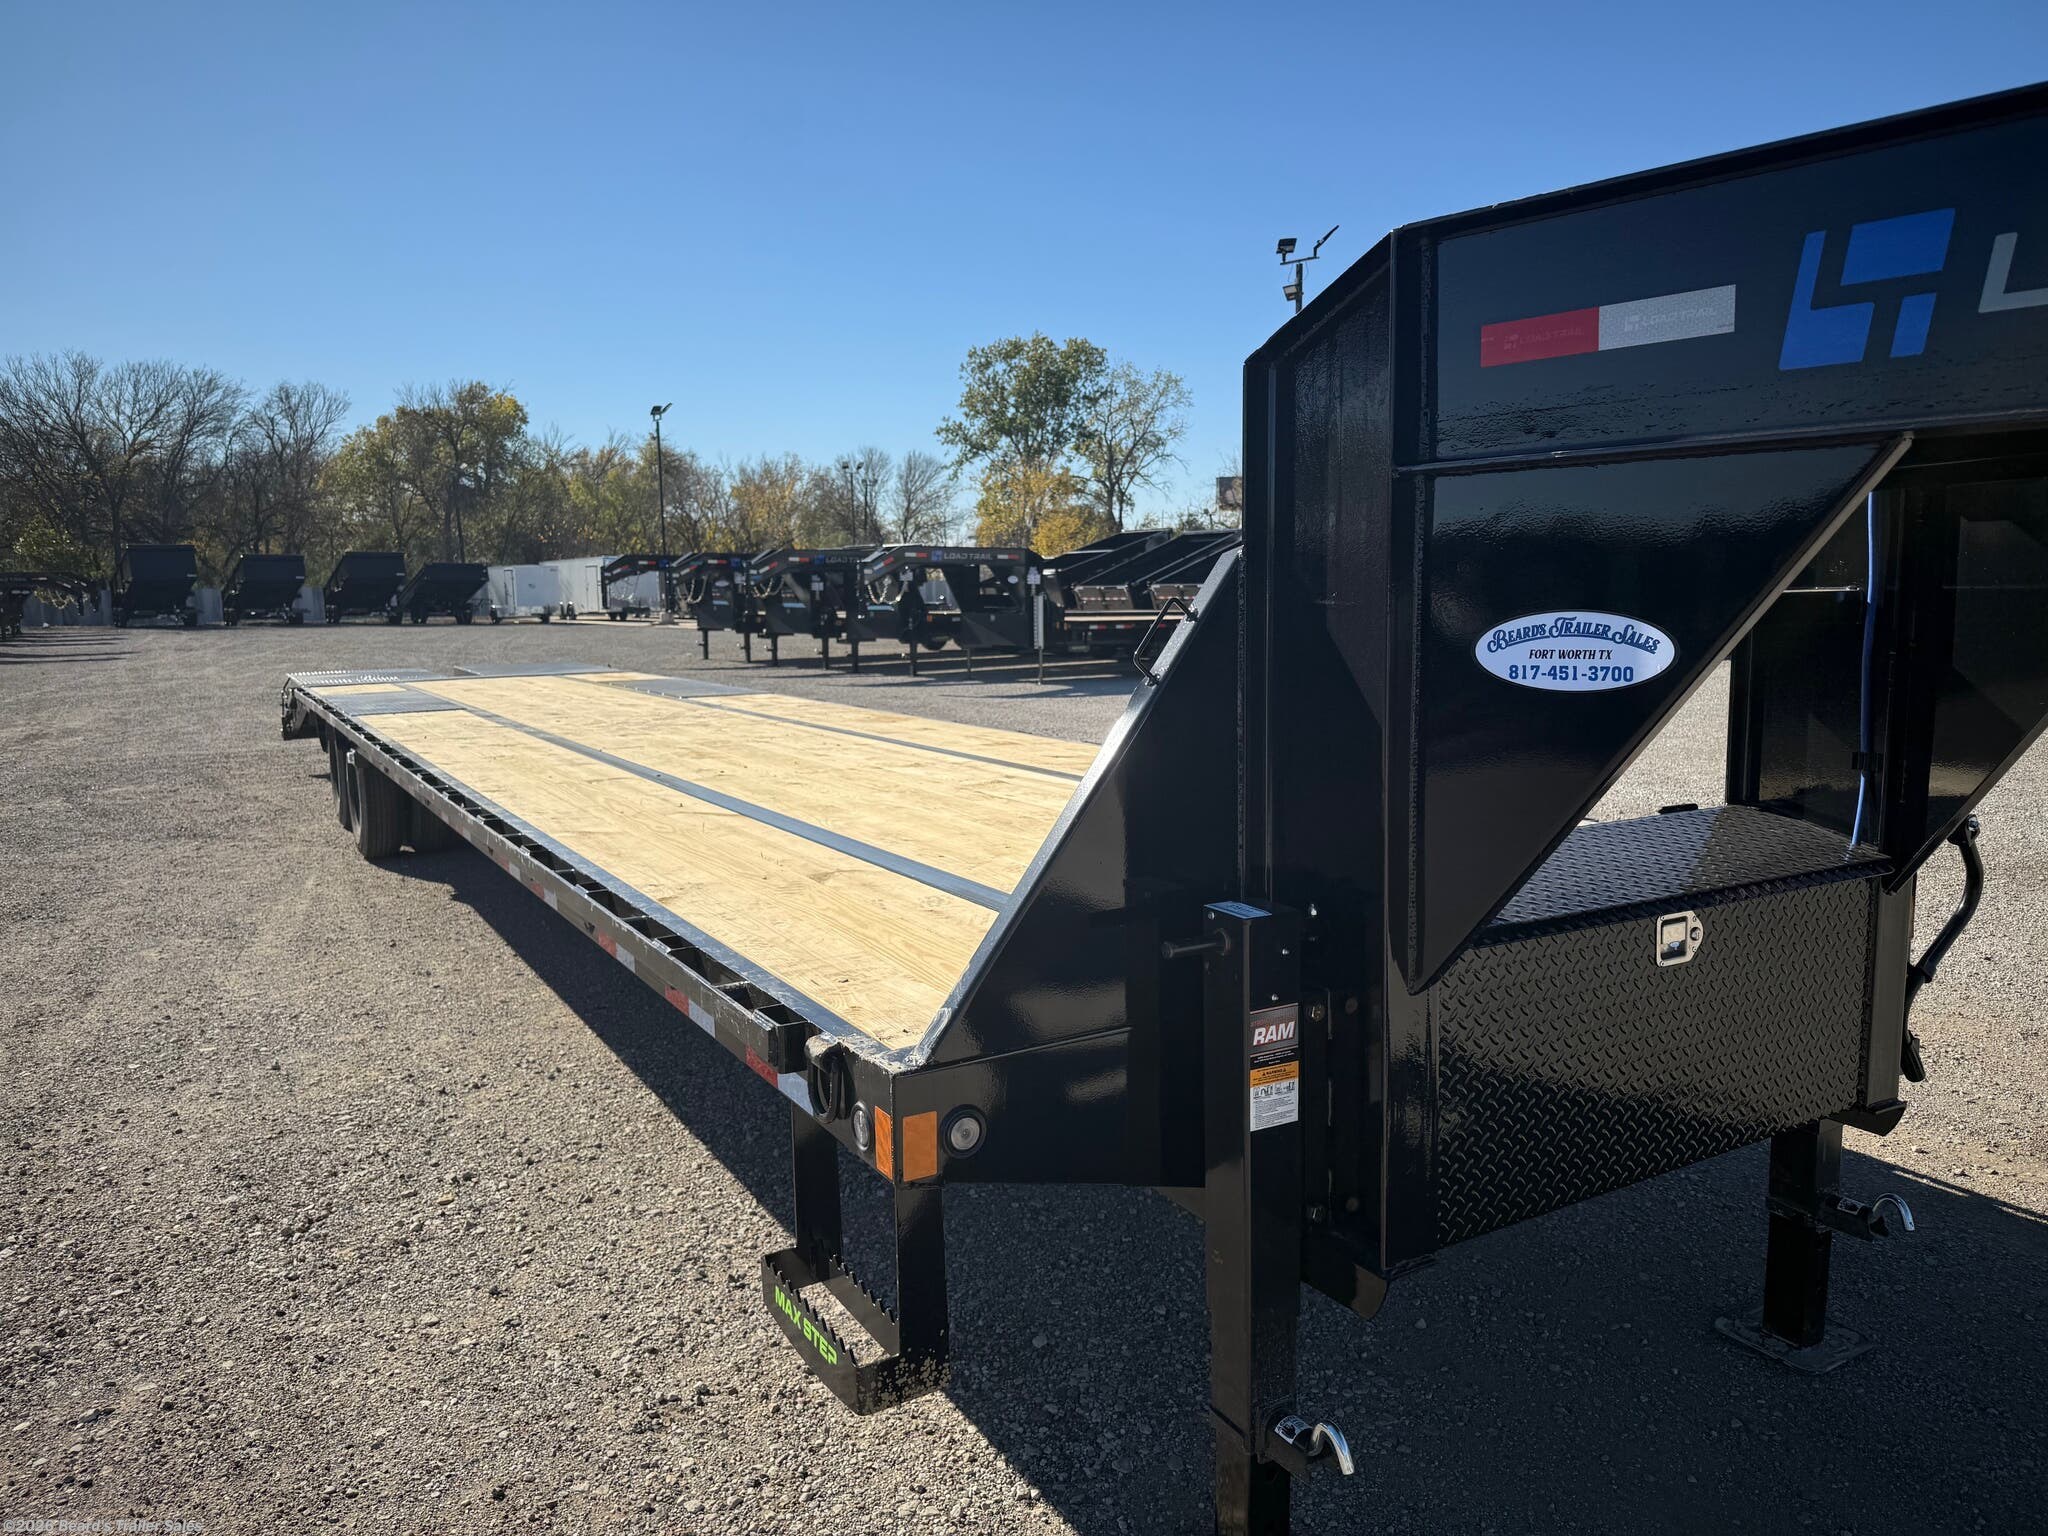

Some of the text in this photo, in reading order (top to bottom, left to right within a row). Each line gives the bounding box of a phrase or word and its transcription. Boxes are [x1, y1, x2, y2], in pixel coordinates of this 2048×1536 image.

[1549, 616, 1611, 639] TRAILER
[1612, 624, 1660, 654] SALES
[1529, 649, 1613, 660] FORT WORTH TX
[1508, 664, 1634, 682] 817-451-3700
[1253, 1020, 1296, 1046] RAM
[775, 1285, 838, 1365] MAX STEP
